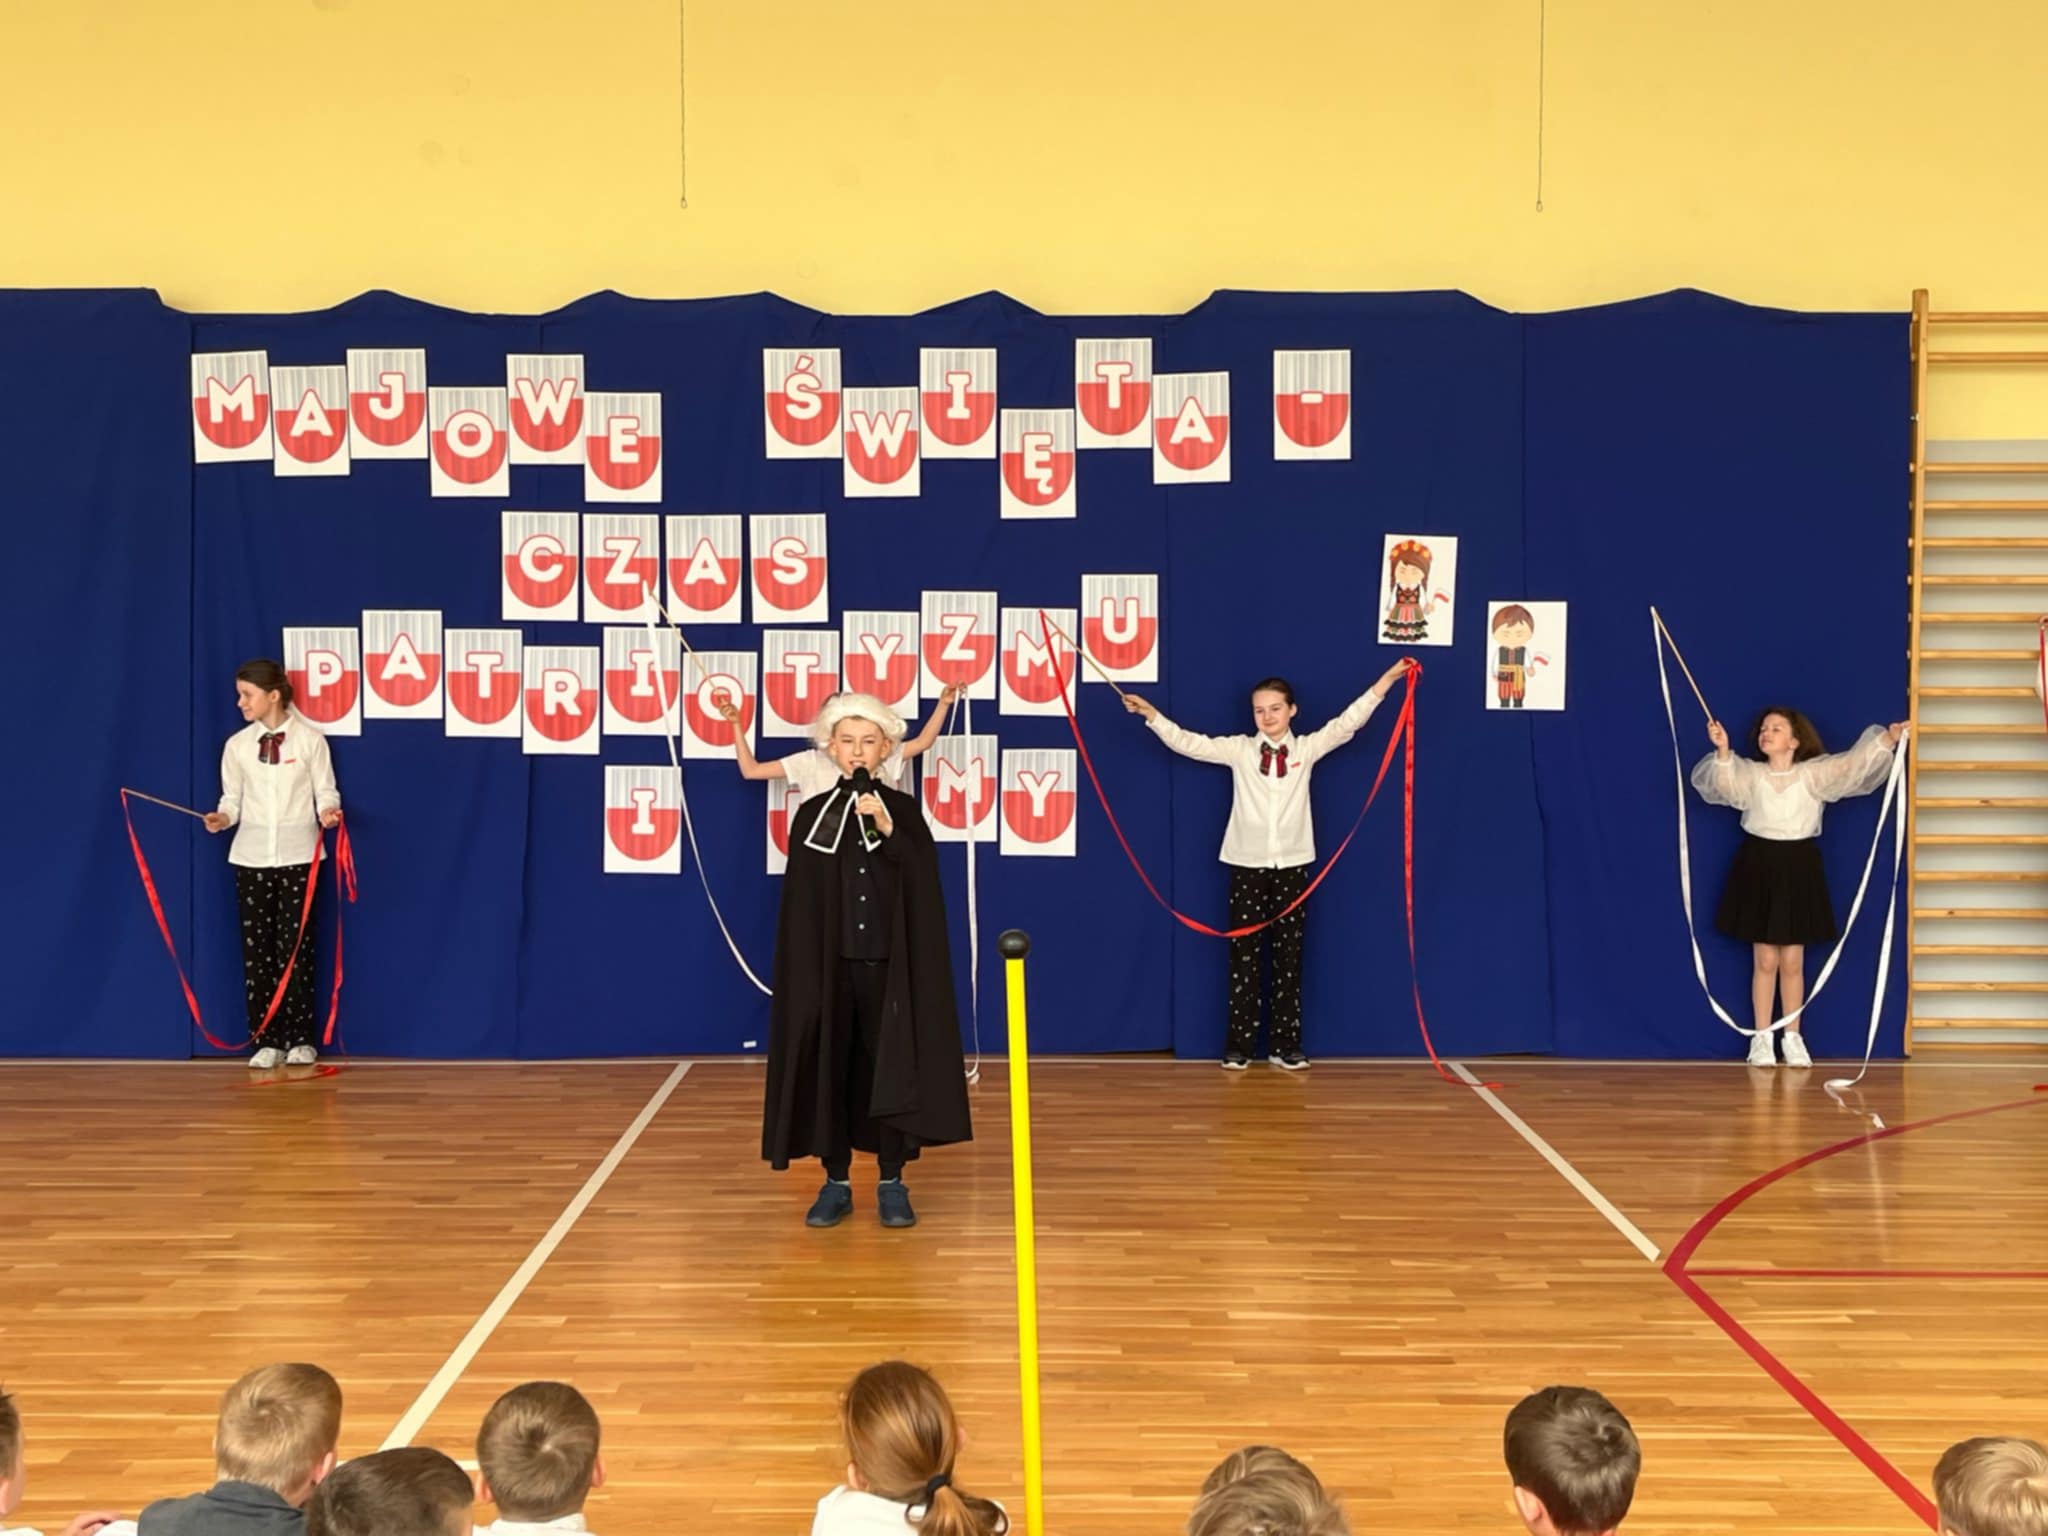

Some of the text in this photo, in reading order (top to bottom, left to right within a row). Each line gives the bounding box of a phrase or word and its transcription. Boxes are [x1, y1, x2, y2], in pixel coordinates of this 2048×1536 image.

[206, 372, 641, 463] MAJOWE
[784, 355, 1214, 495] ŚWIĘTA
[518, 534, 809, 586] CZAS
[305, 597, 1140, 721] PATRIOTYZMU
[631, 788, 656, 836] I
